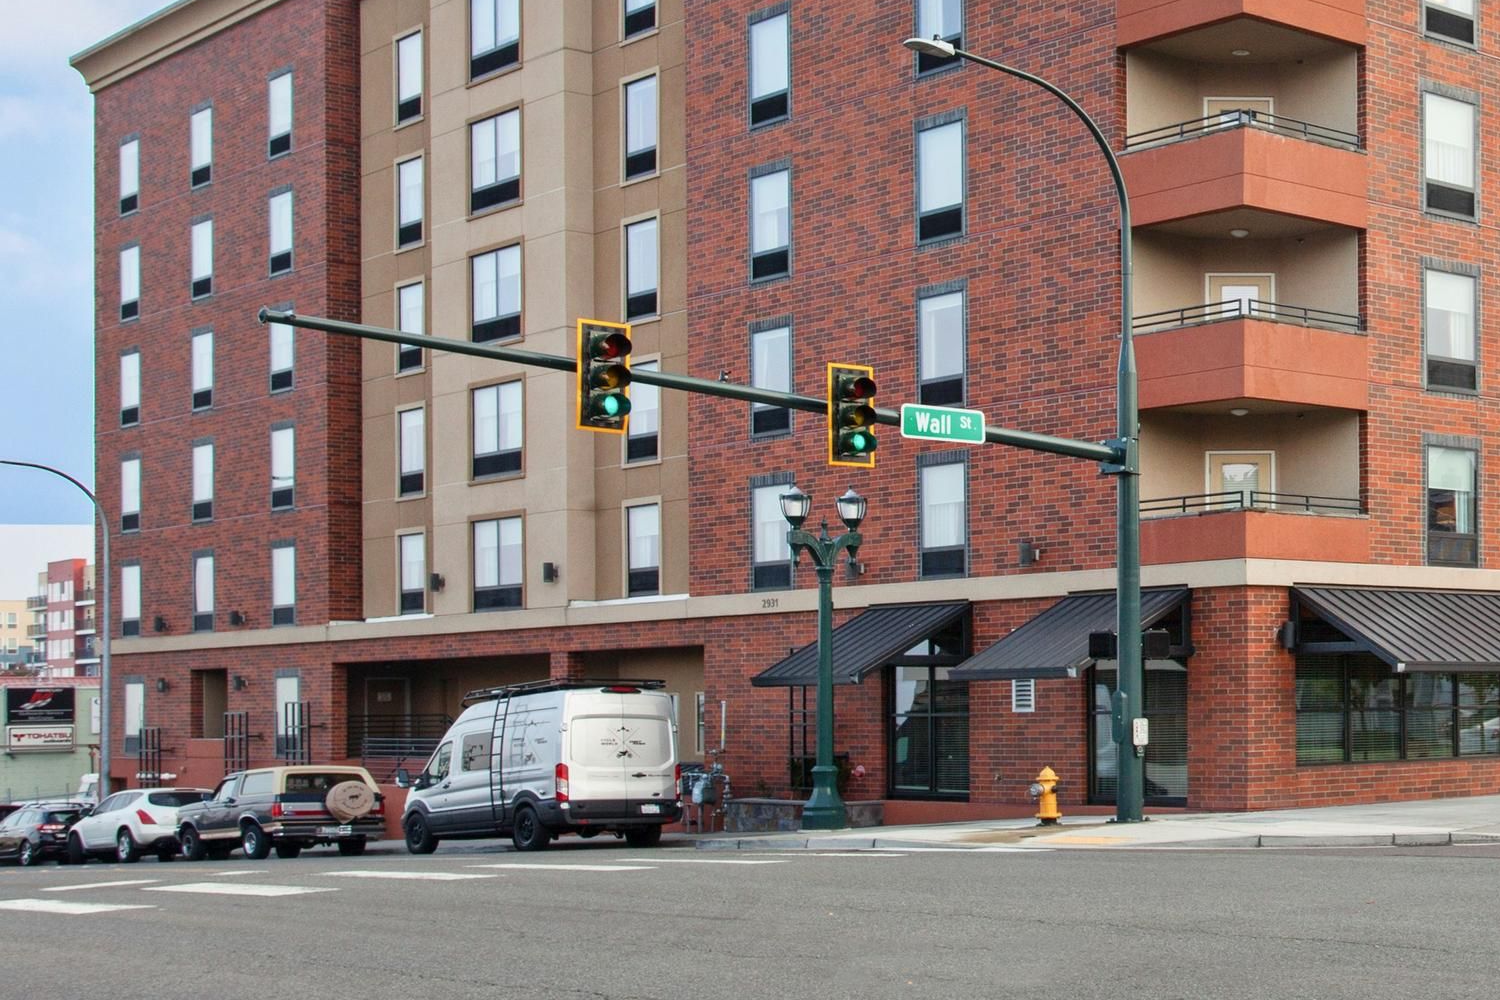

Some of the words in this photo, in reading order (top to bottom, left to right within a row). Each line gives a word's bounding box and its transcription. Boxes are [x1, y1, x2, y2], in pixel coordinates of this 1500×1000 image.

[915, 411, 951, 435] Wall
[761, 598, 779, 608] 2931
[26, 732, 72, 740] TOHATSU
